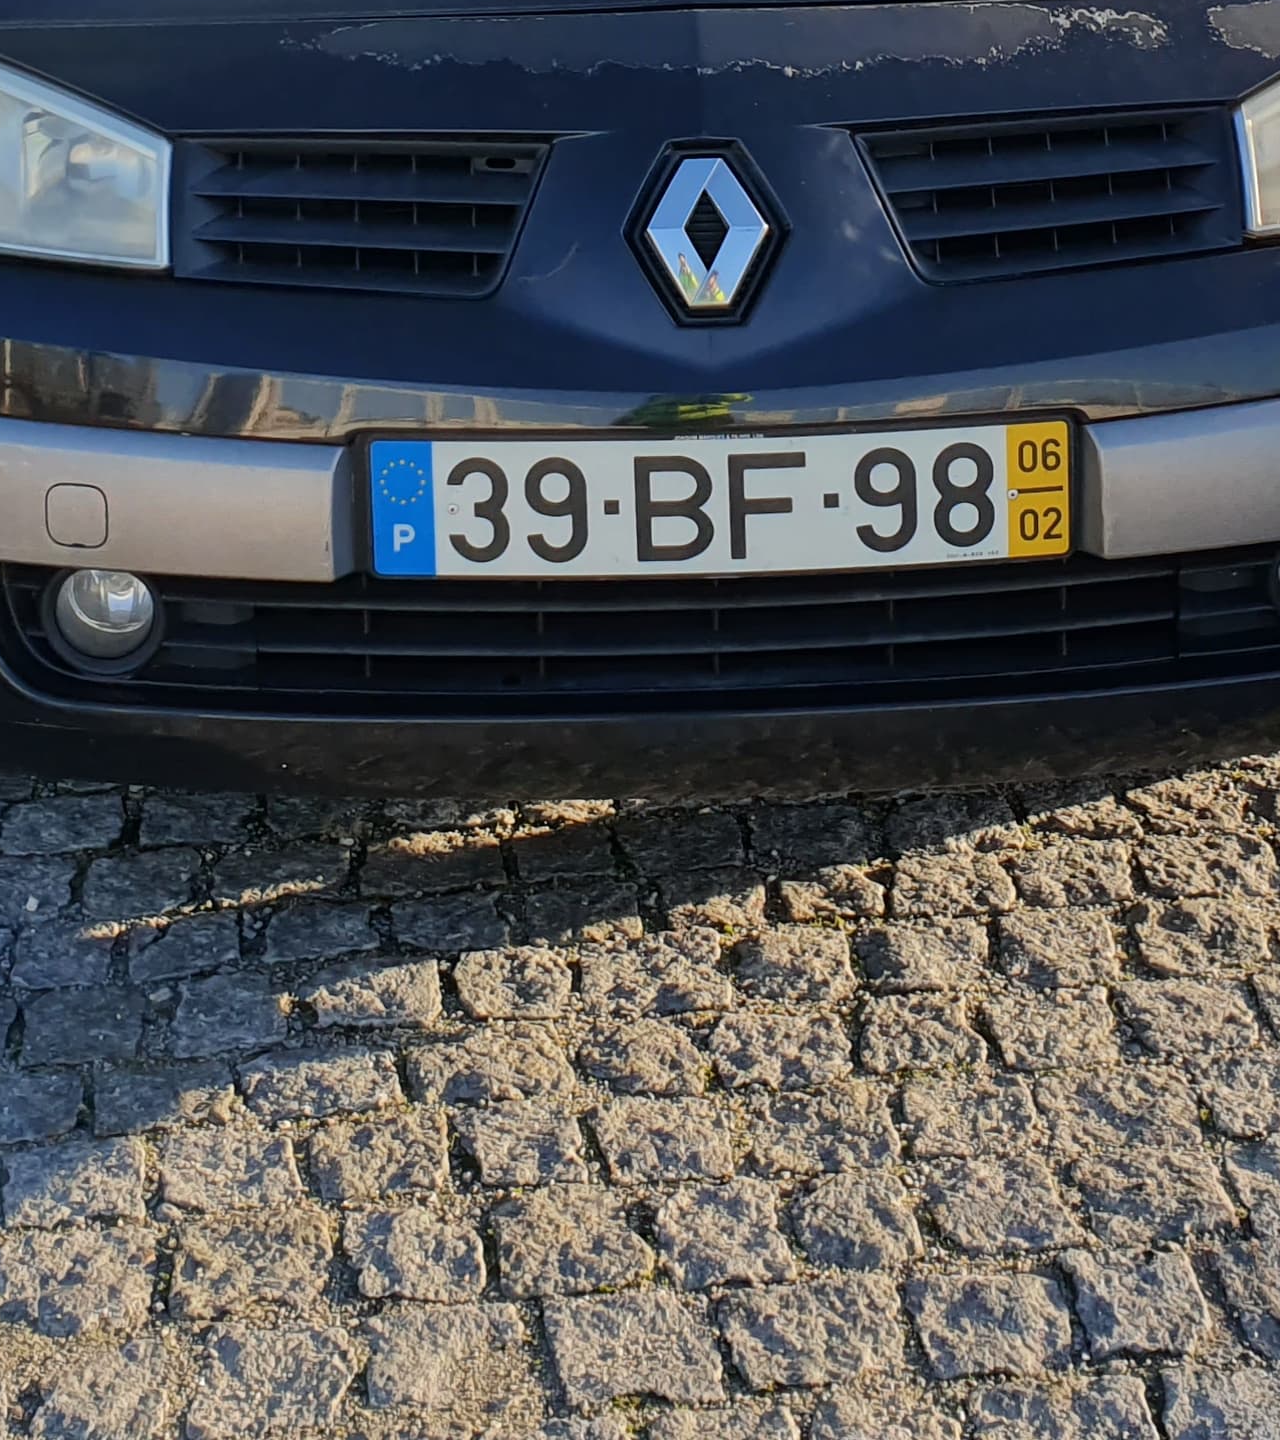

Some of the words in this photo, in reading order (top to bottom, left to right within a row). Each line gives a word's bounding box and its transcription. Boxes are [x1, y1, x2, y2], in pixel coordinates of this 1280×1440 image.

[1018, 438, 1061, 473] 06
[393, 524, 416, 552] P
[1020, 507, 1063, 541] 02
